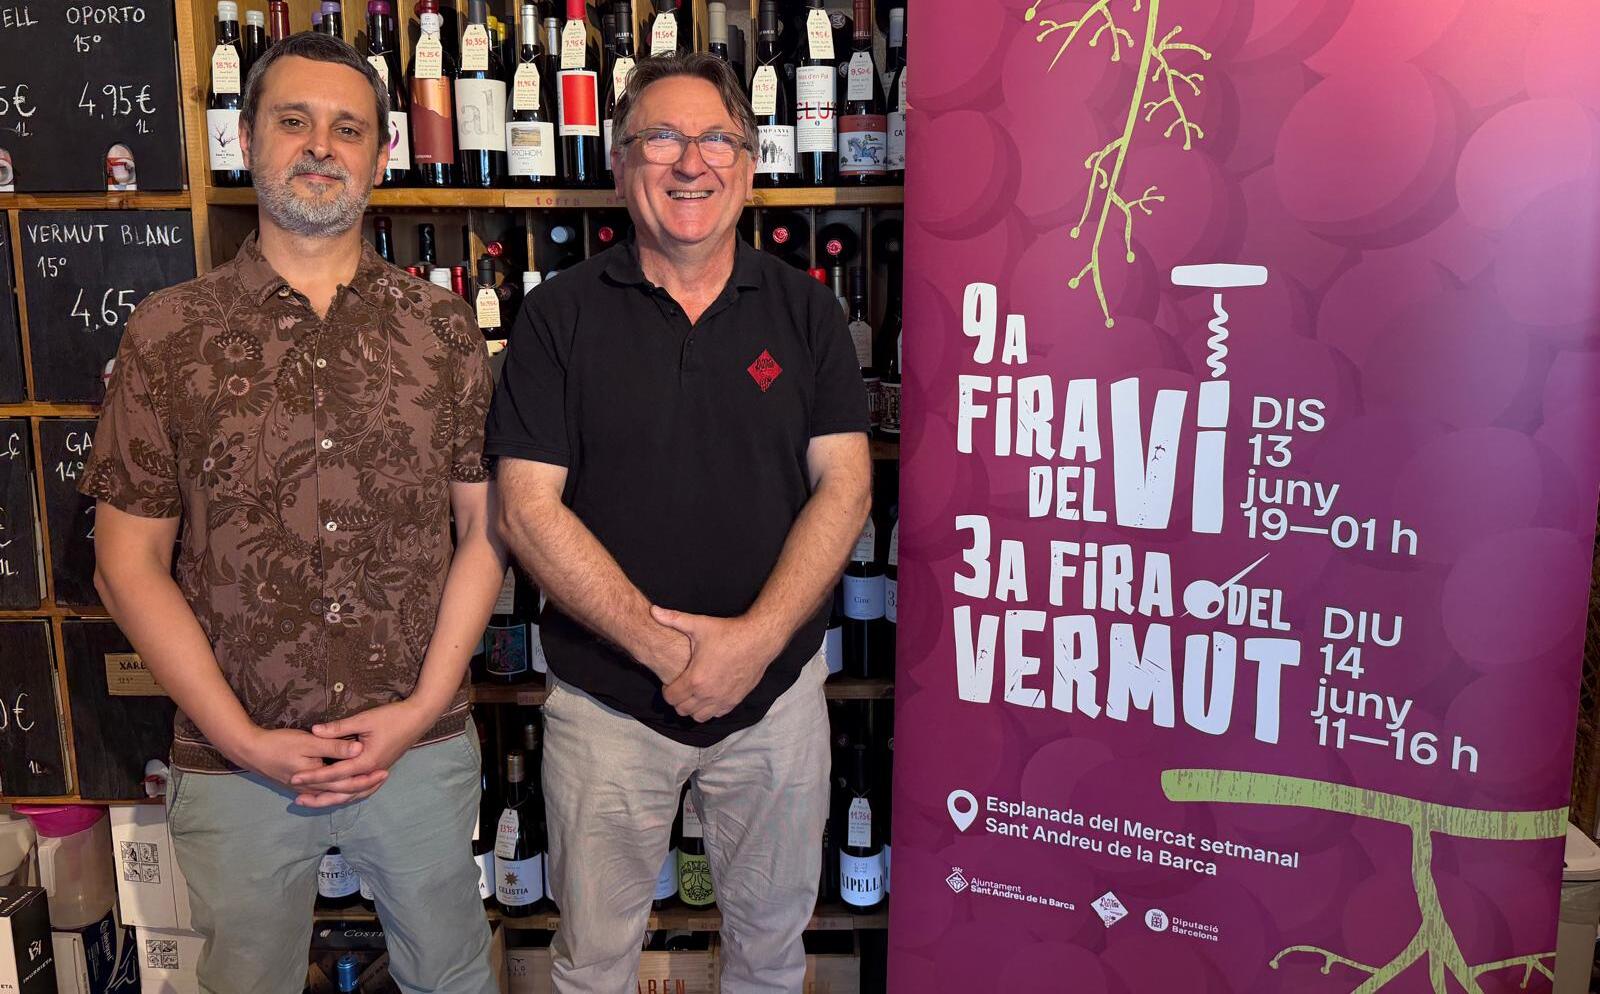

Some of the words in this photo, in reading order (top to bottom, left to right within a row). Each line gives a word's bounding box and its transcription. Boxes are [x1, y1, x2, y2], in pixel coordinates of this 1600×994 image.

[66, 5, 146, 25] OPORTO
[27, 224, 109, 245] VERMUT
[121, 224, 183, 247] BLANC
[70, 288, 137, 330] 4,65
[1251, 396, 1326, 432] DIS
[1248, 434, 1293, 468] 13
[1028, 466, 1107, 522] DEL
[1240, 468, 1340, 517] juny
[1391, 519, 1418, 556] h
[1227, 583, 1291, 631] DEL
[1323, 606, 1403, 647] DIU
[953, 605, 1301, 744] VERMUT
[1319, 643, 1365, 680] 14
[1310, 677, 1413, 730] juny
[1451, 735, 1479, 773] h
[985, 818, 1028, 839] Sant
[1033, 825, 1103, 853] Andreu
[1107, 840, 1132, 859] de
[1137, 845, 1153, 863] la
[1159, 850, 1217, 876] Barca
[986, 796, 1084, 827] Esplanada
[1088, 814, 1119, 833] del
[1123, 820, 1196, 849] Mercat
[1199, 836, 1299, 868] setmanal
[970, 877, 1021, 892] Ajuntament
[970, 884, 991, 895] Sant
[992, 888, 1025, 901] Andreu
[1026, 894, 1038, 903] de
[1039, 896, 1048, 905] la
[1049, 897, 1075, 911] Barca
[1171, 925, 1218, 942] Barcelona
[1172, 917, 1219, 933] Diputació
